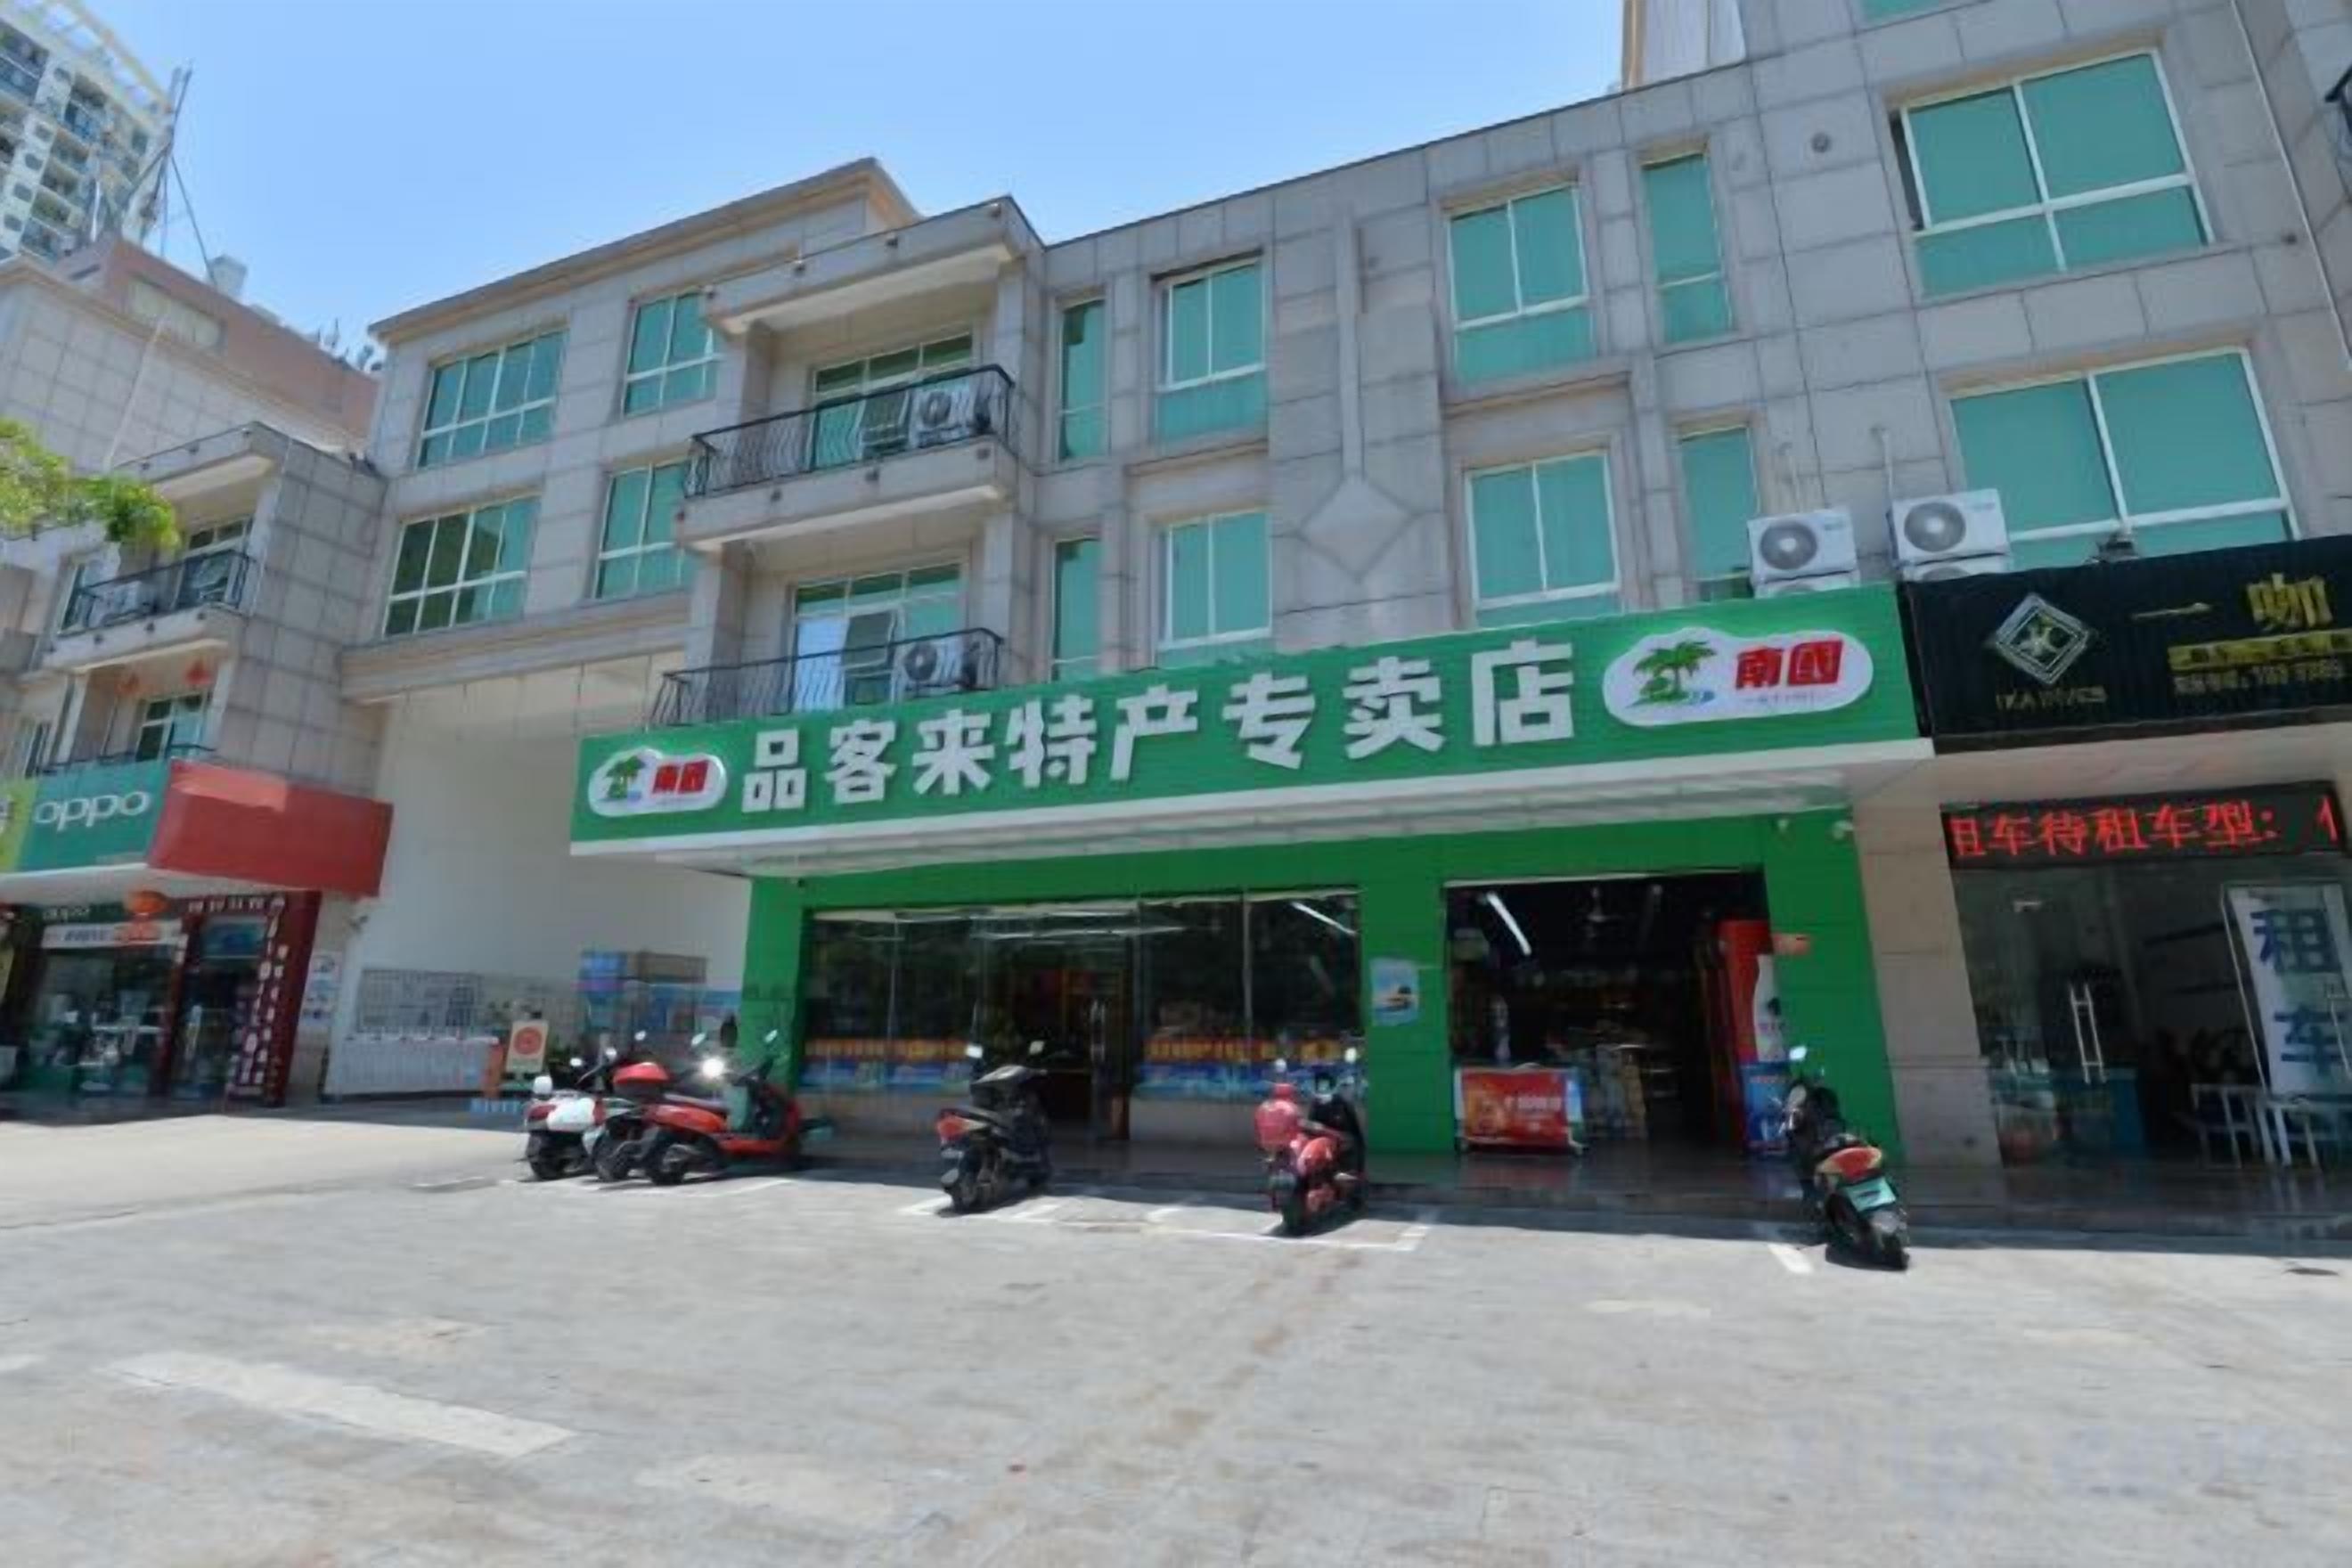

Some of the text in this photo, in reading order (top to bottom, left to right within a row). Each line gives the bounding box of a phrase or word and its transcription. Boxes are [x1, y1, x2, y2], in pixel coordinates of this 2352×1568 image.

[741, 638, 1576, 813] 品客来特产专卖店
